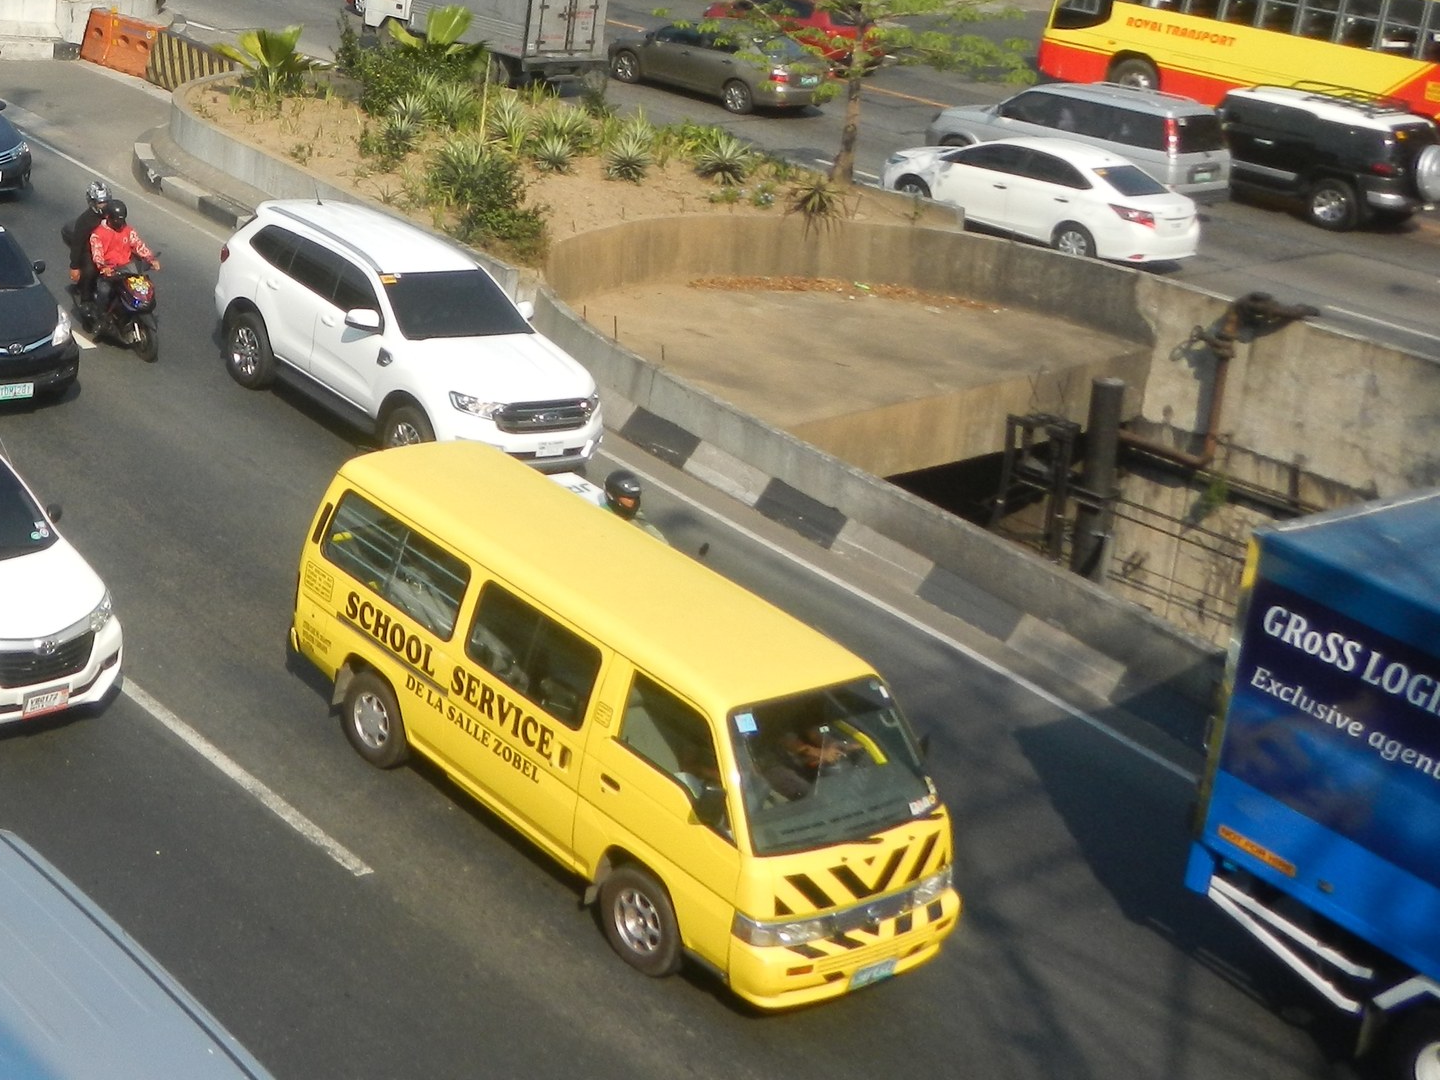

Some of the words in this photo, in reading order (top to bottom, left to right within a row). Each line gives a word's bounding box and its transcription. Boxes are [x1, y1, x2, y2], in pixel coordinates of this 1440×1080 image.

[1126, 17, 1161, 32] ROYAL
[1165, 24, 1236, 46] TRANSPORT
[346, 591, 435, 677] SCHOOL
[451, 665, 554, 761] SERVICE
[1251, 666, 1364, 737] Exclusive
[405, 674, 424, 698] DE
[427, 691, 444, 715] LA
[447, 706, 490, 748] SALLE
[493, 738, 539, 784] ZOBEL
